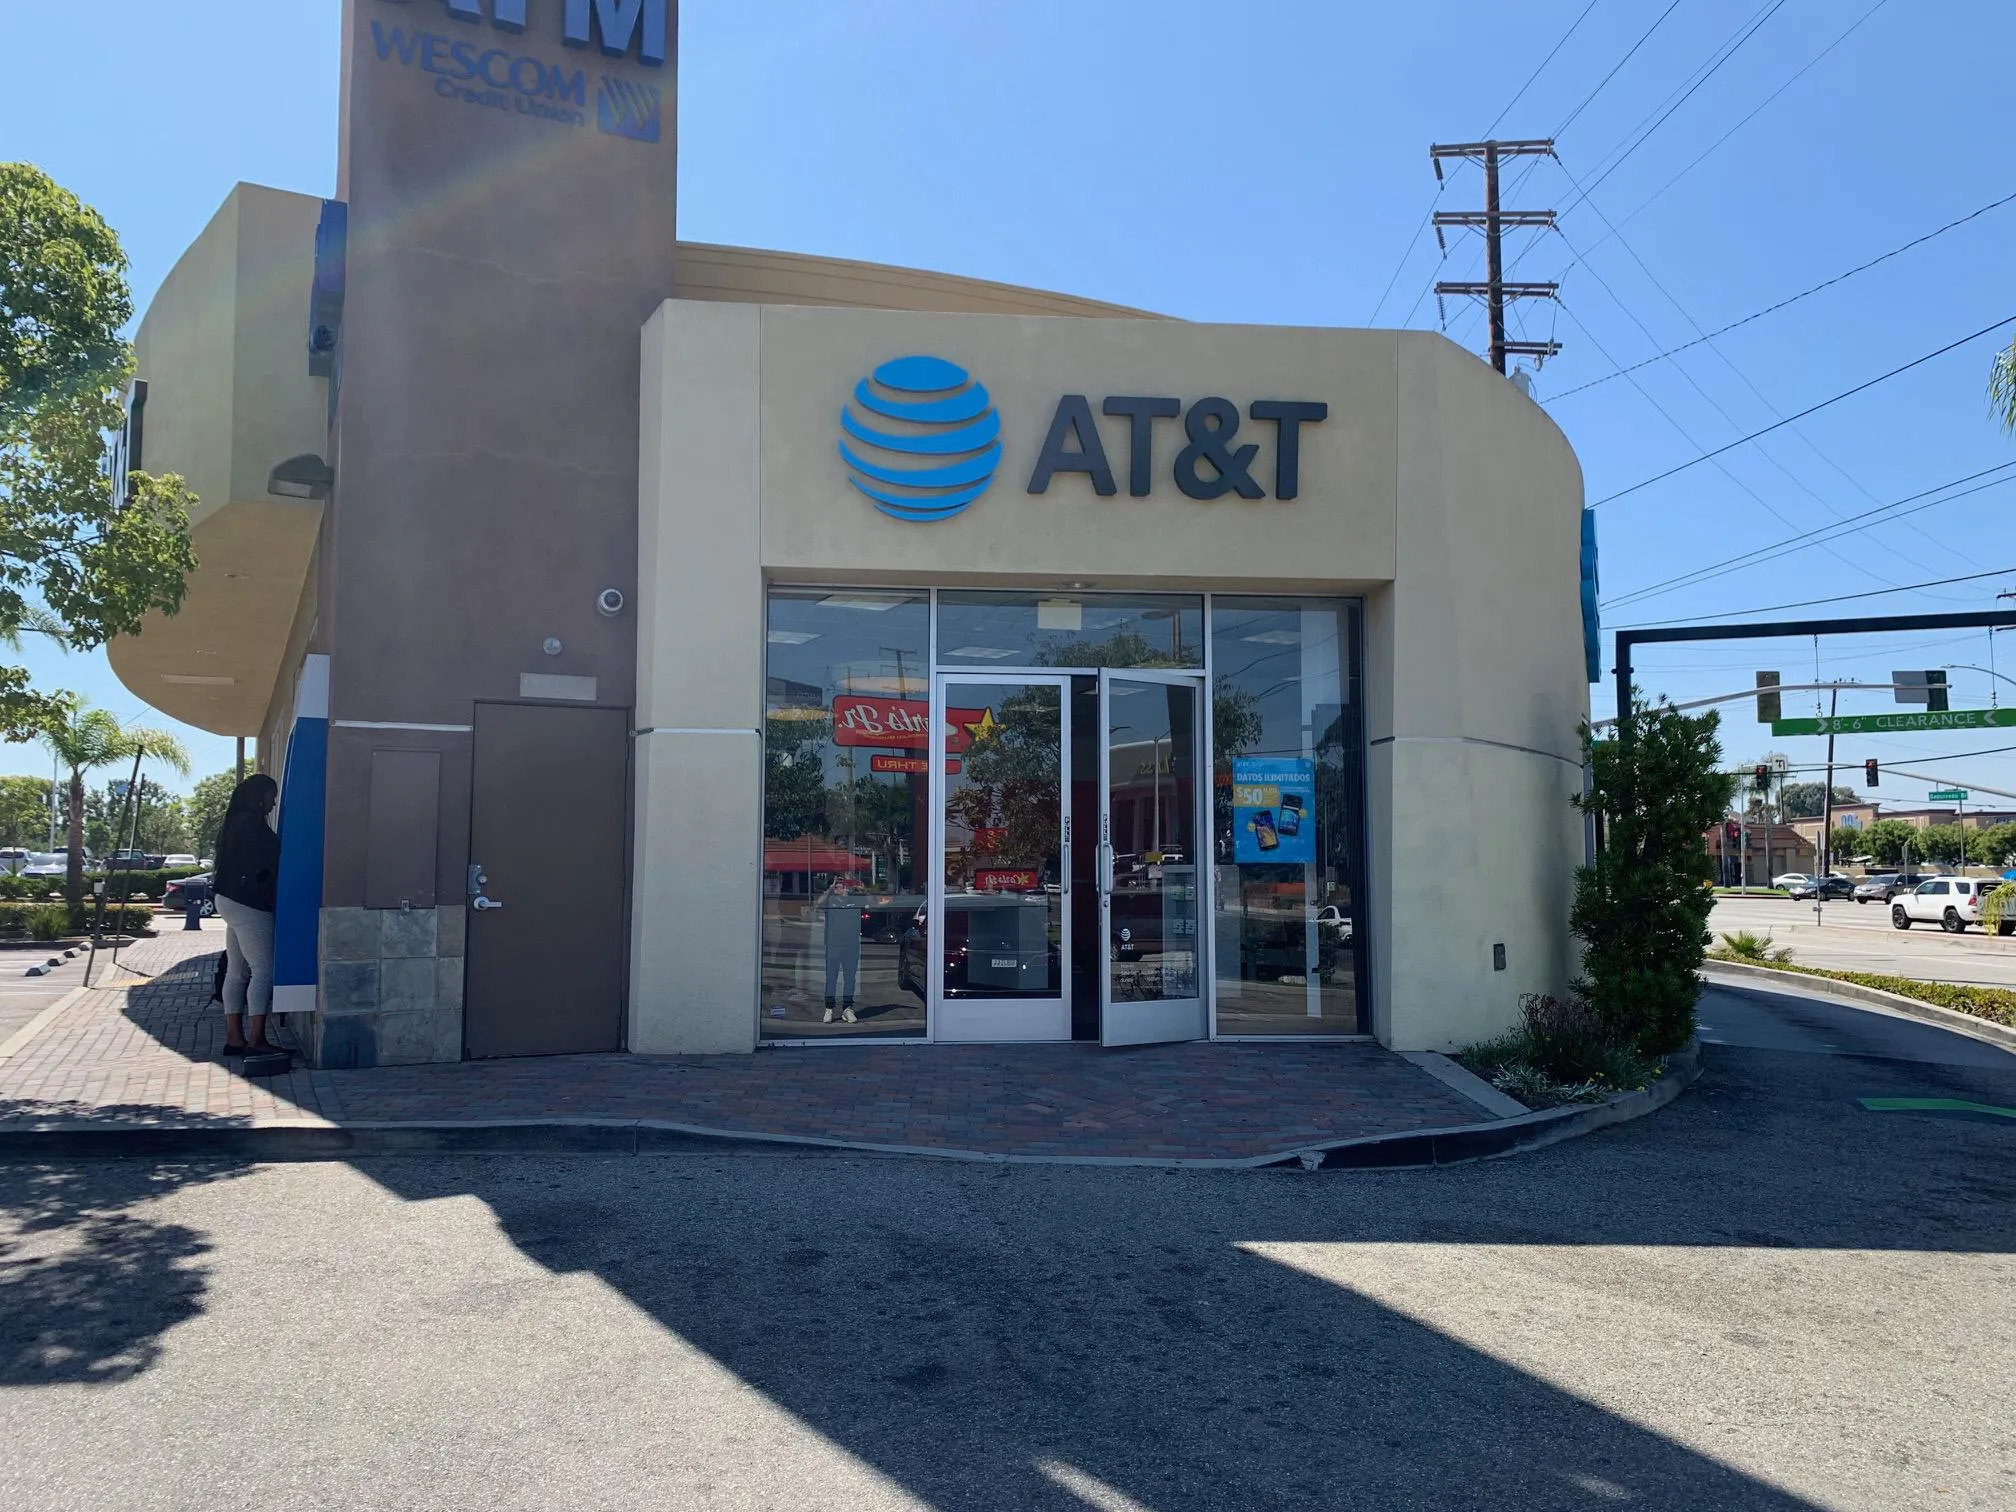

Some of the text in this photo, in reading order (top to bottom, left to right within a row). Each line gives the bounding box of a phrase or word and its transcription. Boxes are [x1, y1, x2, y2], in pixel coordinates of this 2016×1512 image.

[370, 20, 586, 107] WESCOM
[435, 77, 584, 127] Credit Union
[1027, 394, 1328, 500] AT&T
[1875, 712, 1976, 729] CLEARANCE
[1236, 773, 1263, 783] DATOS
[1120, 943, 1135, 951] AT&T
